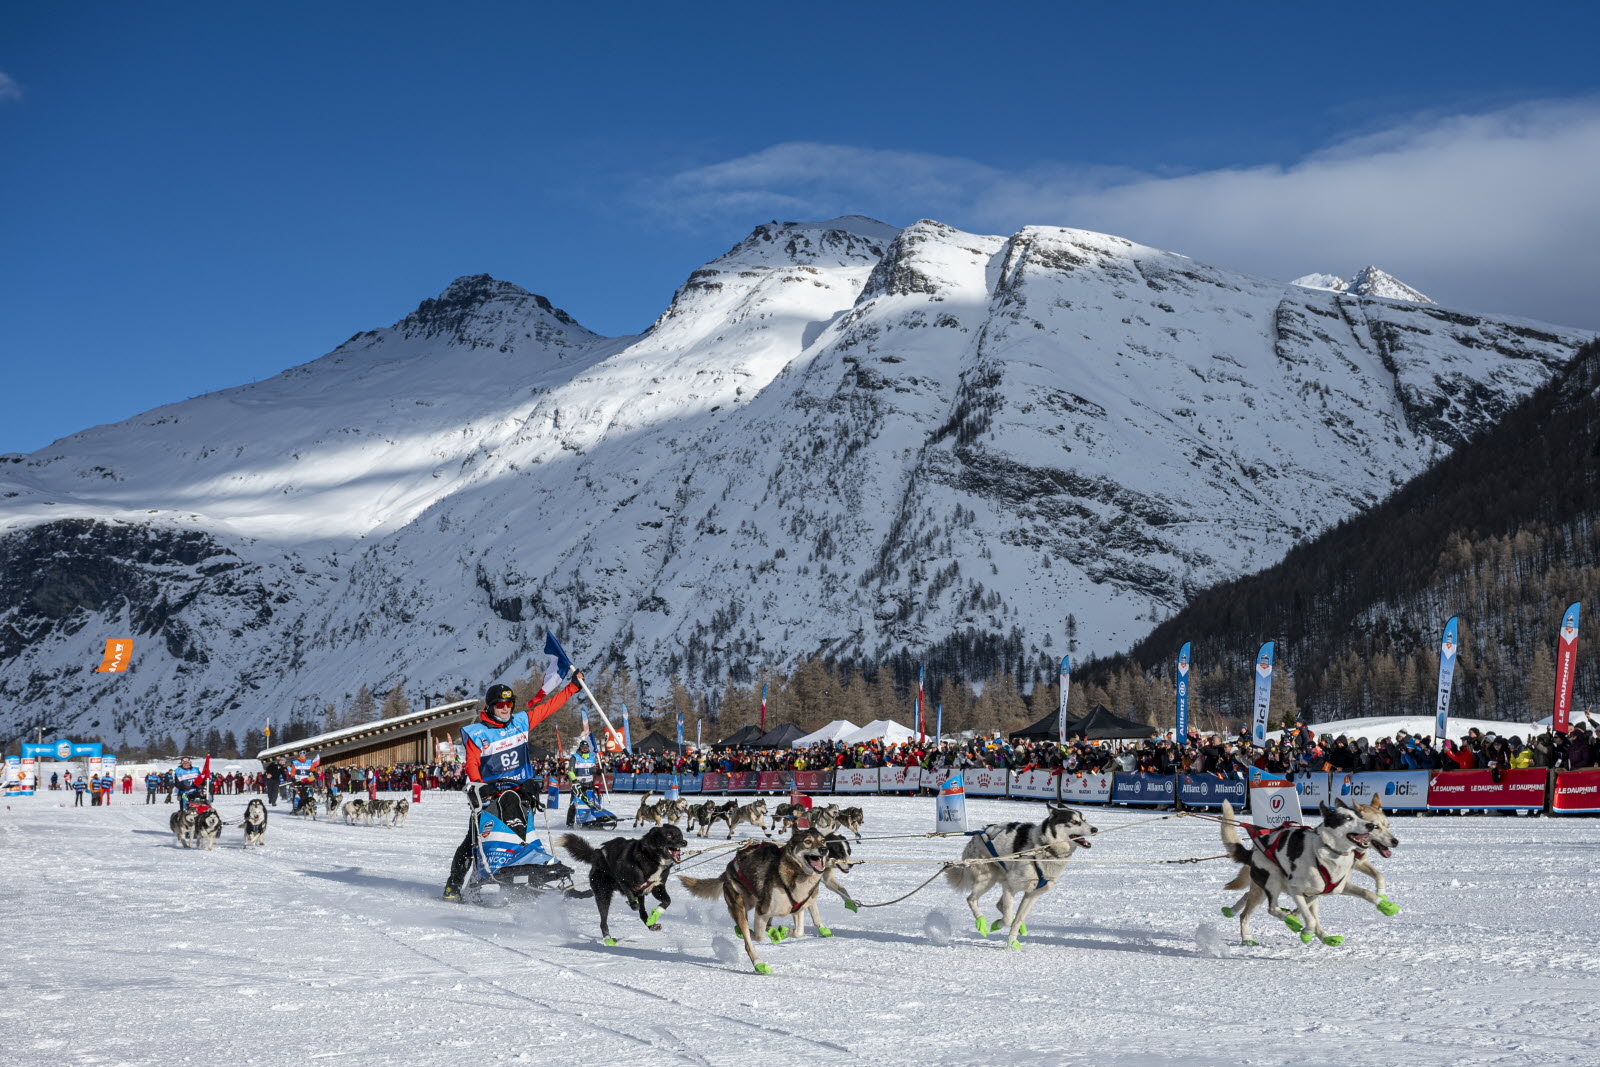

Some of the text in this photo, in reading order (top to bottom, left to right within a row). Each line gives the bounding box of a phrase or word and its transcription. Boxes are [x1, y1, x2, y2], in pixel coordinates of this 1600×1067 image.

[1439, 688, 1449, 711] ici
[1256, 703, 1267, 724] ici
[500, 750, 520, 767] 62
[1117, 782, 1134, 791] Allianz
[1147, 782, 1164, 791] Allianz
[1182, 784, 1200, 793] Allianz
[1215, 783, 1236, 793] Allianz
[1303, 781, 1313, 796] ici
[1350, 781, 1363, 796] ici
[1396, 780, 1409, 796] ici
[1272, 799, 1281, 809] U
